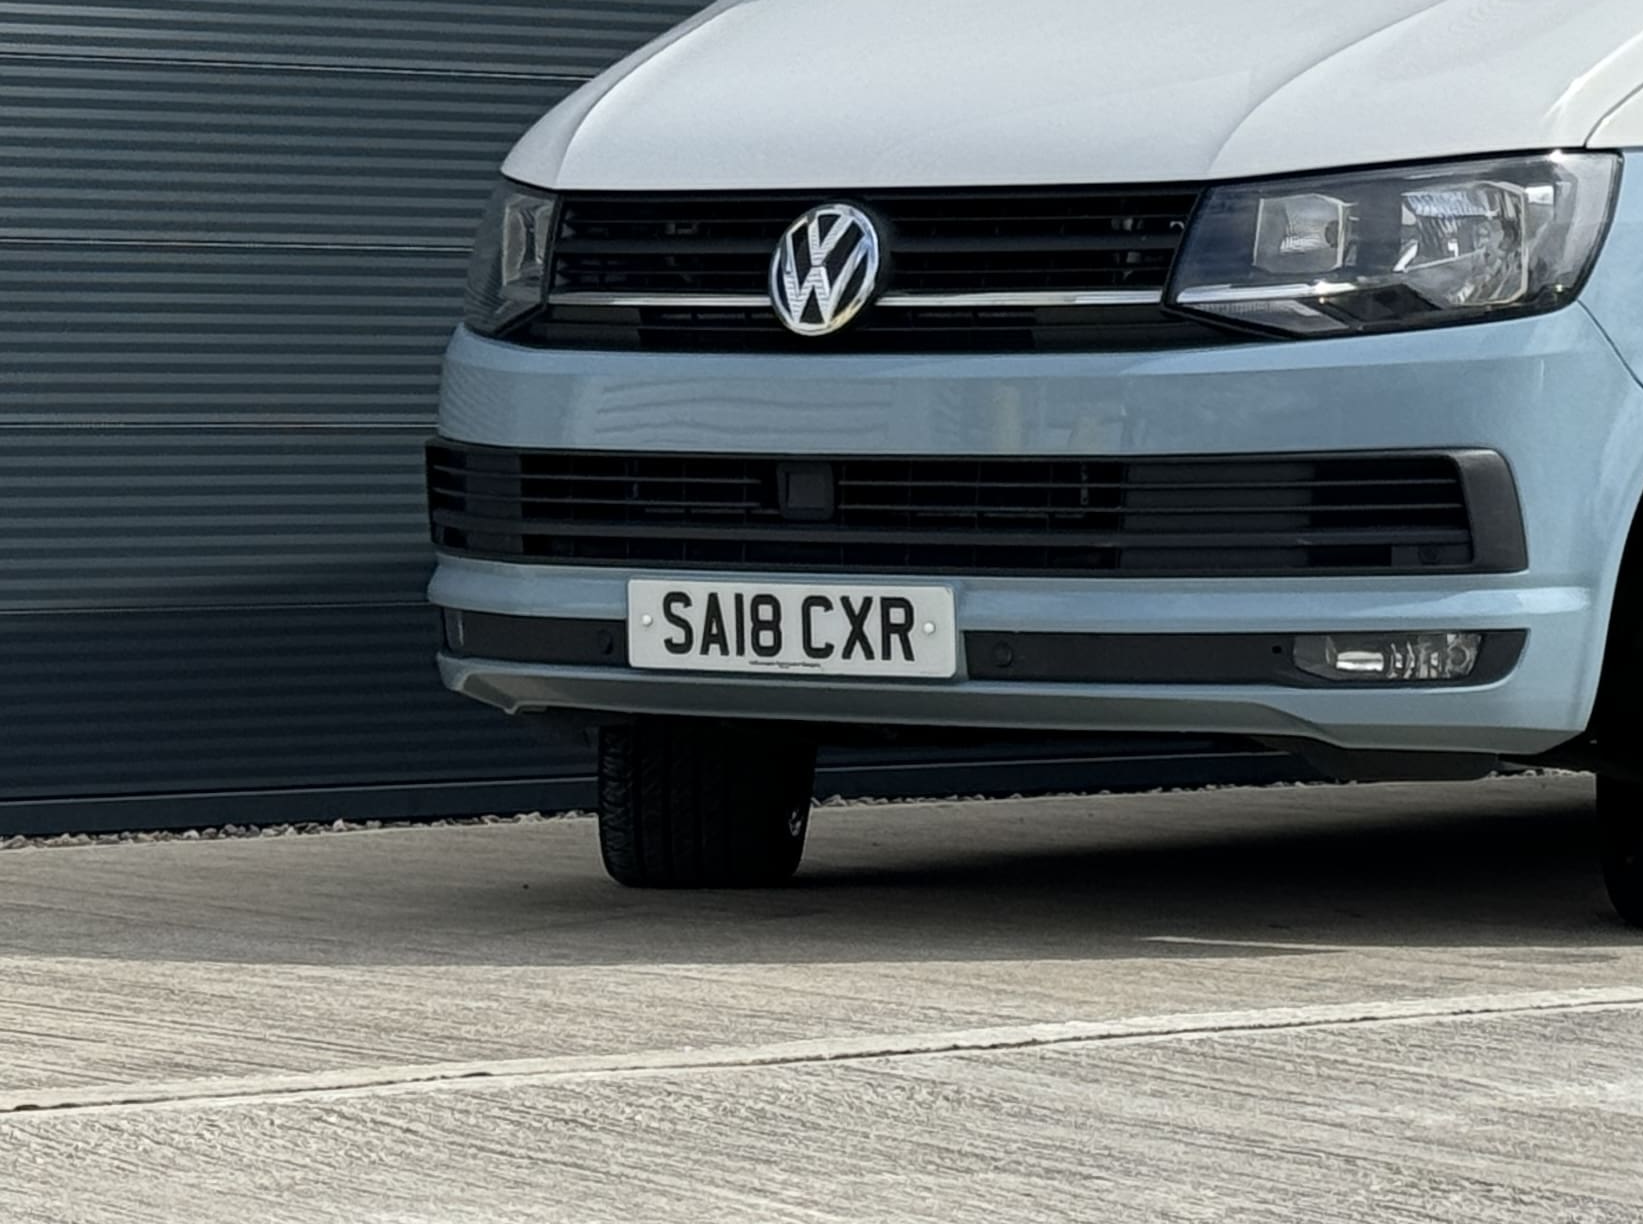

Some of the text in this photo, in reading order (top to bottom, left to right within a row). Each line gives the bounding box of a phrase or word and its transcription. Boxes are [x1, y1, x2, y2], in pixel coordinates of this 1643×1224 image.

[770, 203, 879, 336] VW
[662, 591, 915, 661] SA18 CXR
